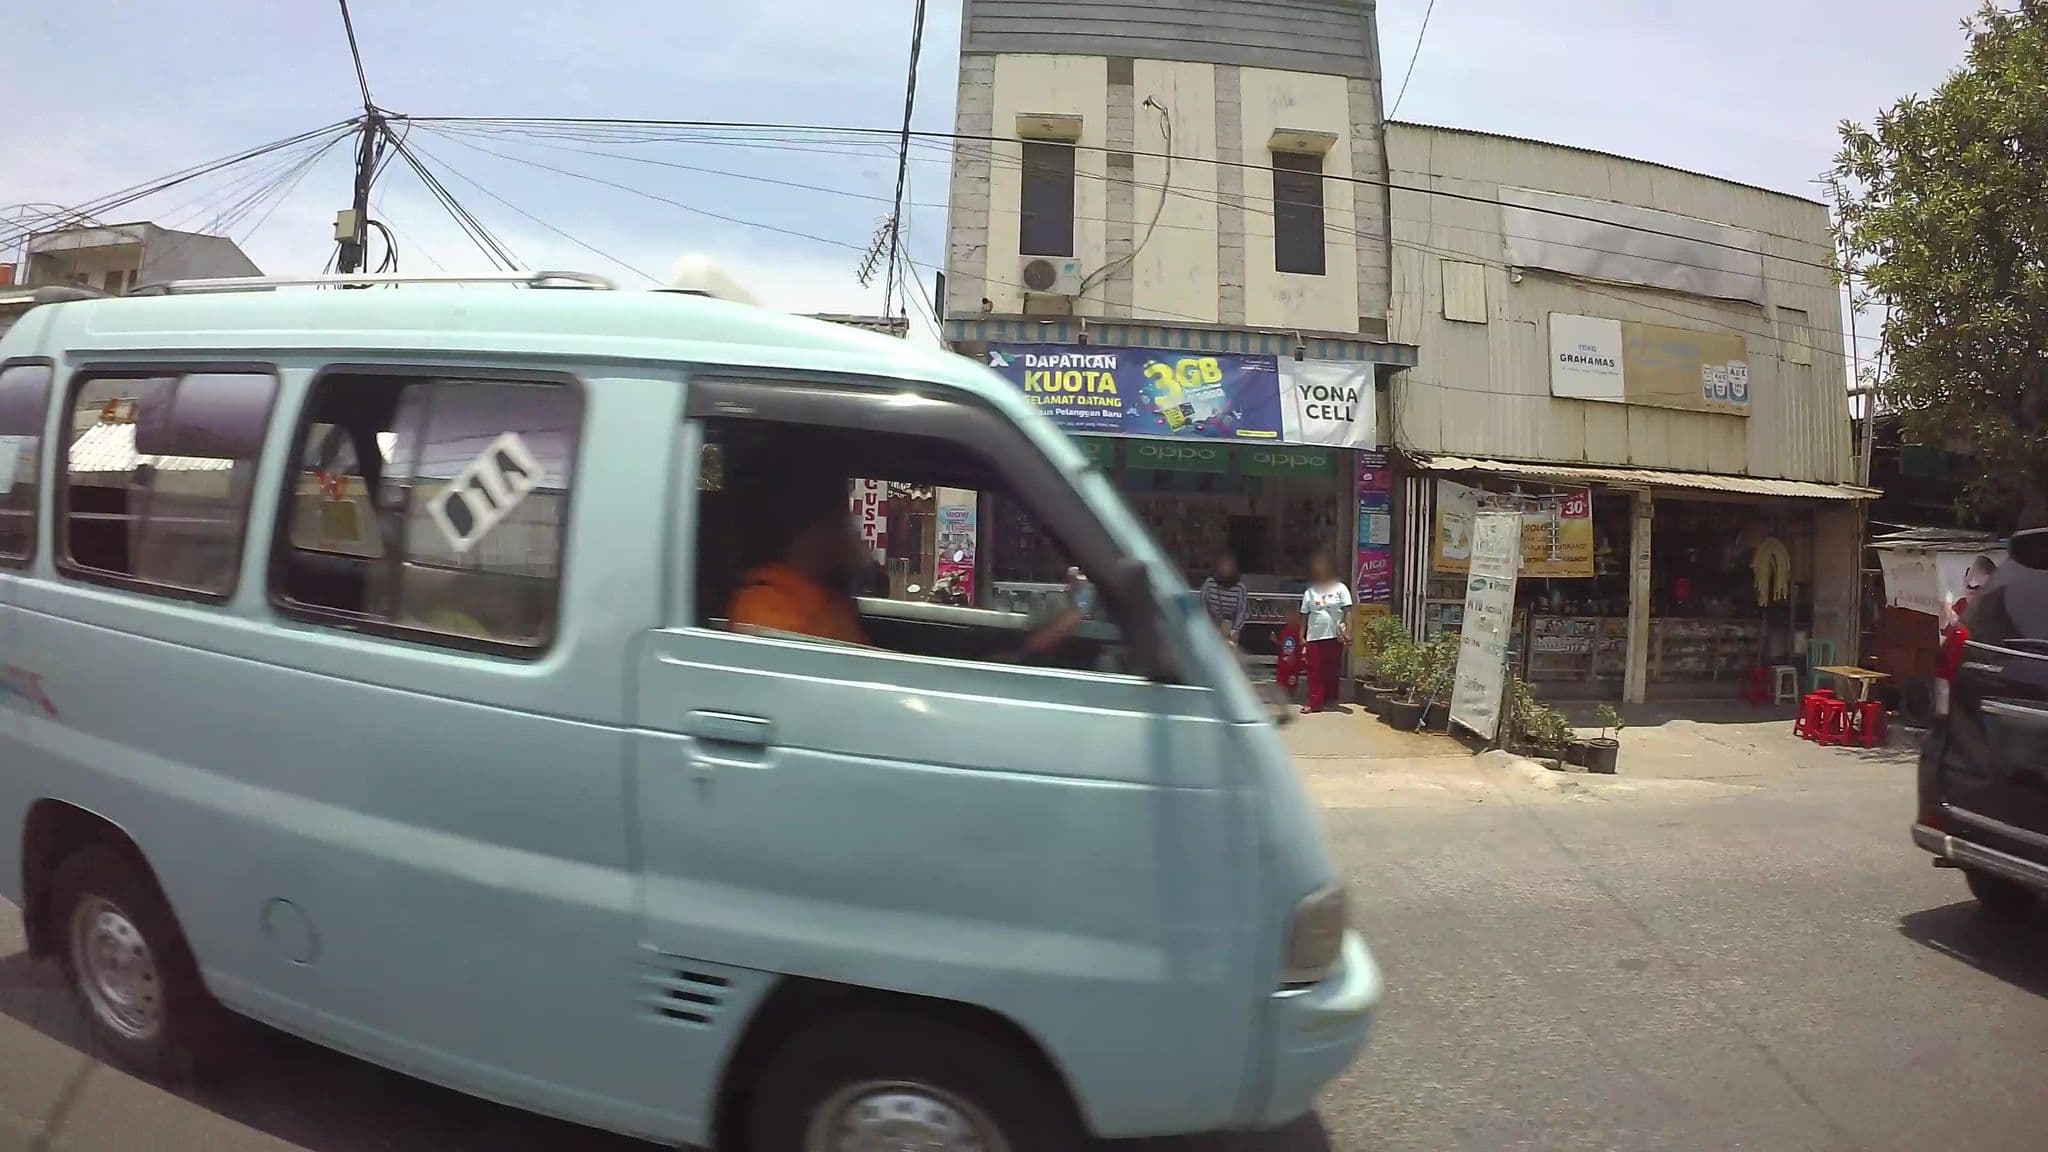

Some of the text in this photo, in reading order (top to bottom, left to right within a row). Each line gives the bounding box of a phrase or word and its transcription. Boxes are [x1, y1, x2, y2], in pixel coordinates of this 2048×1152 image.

[1025, 353, 1117, 370] DAPATKAN
[1559, 353, 1615, 368] GRAHAMAS
[1024, 370, 1117, 394] KUOTA
[1077, 396, 1122, 408] DATANG
[1298, 384, 1358, 404] YONA
[1055, 408, 1101, 418] Pelanggan
[1102, 409, 1122, 418] Baru
[1305, 403, 1355, 423] CELL
